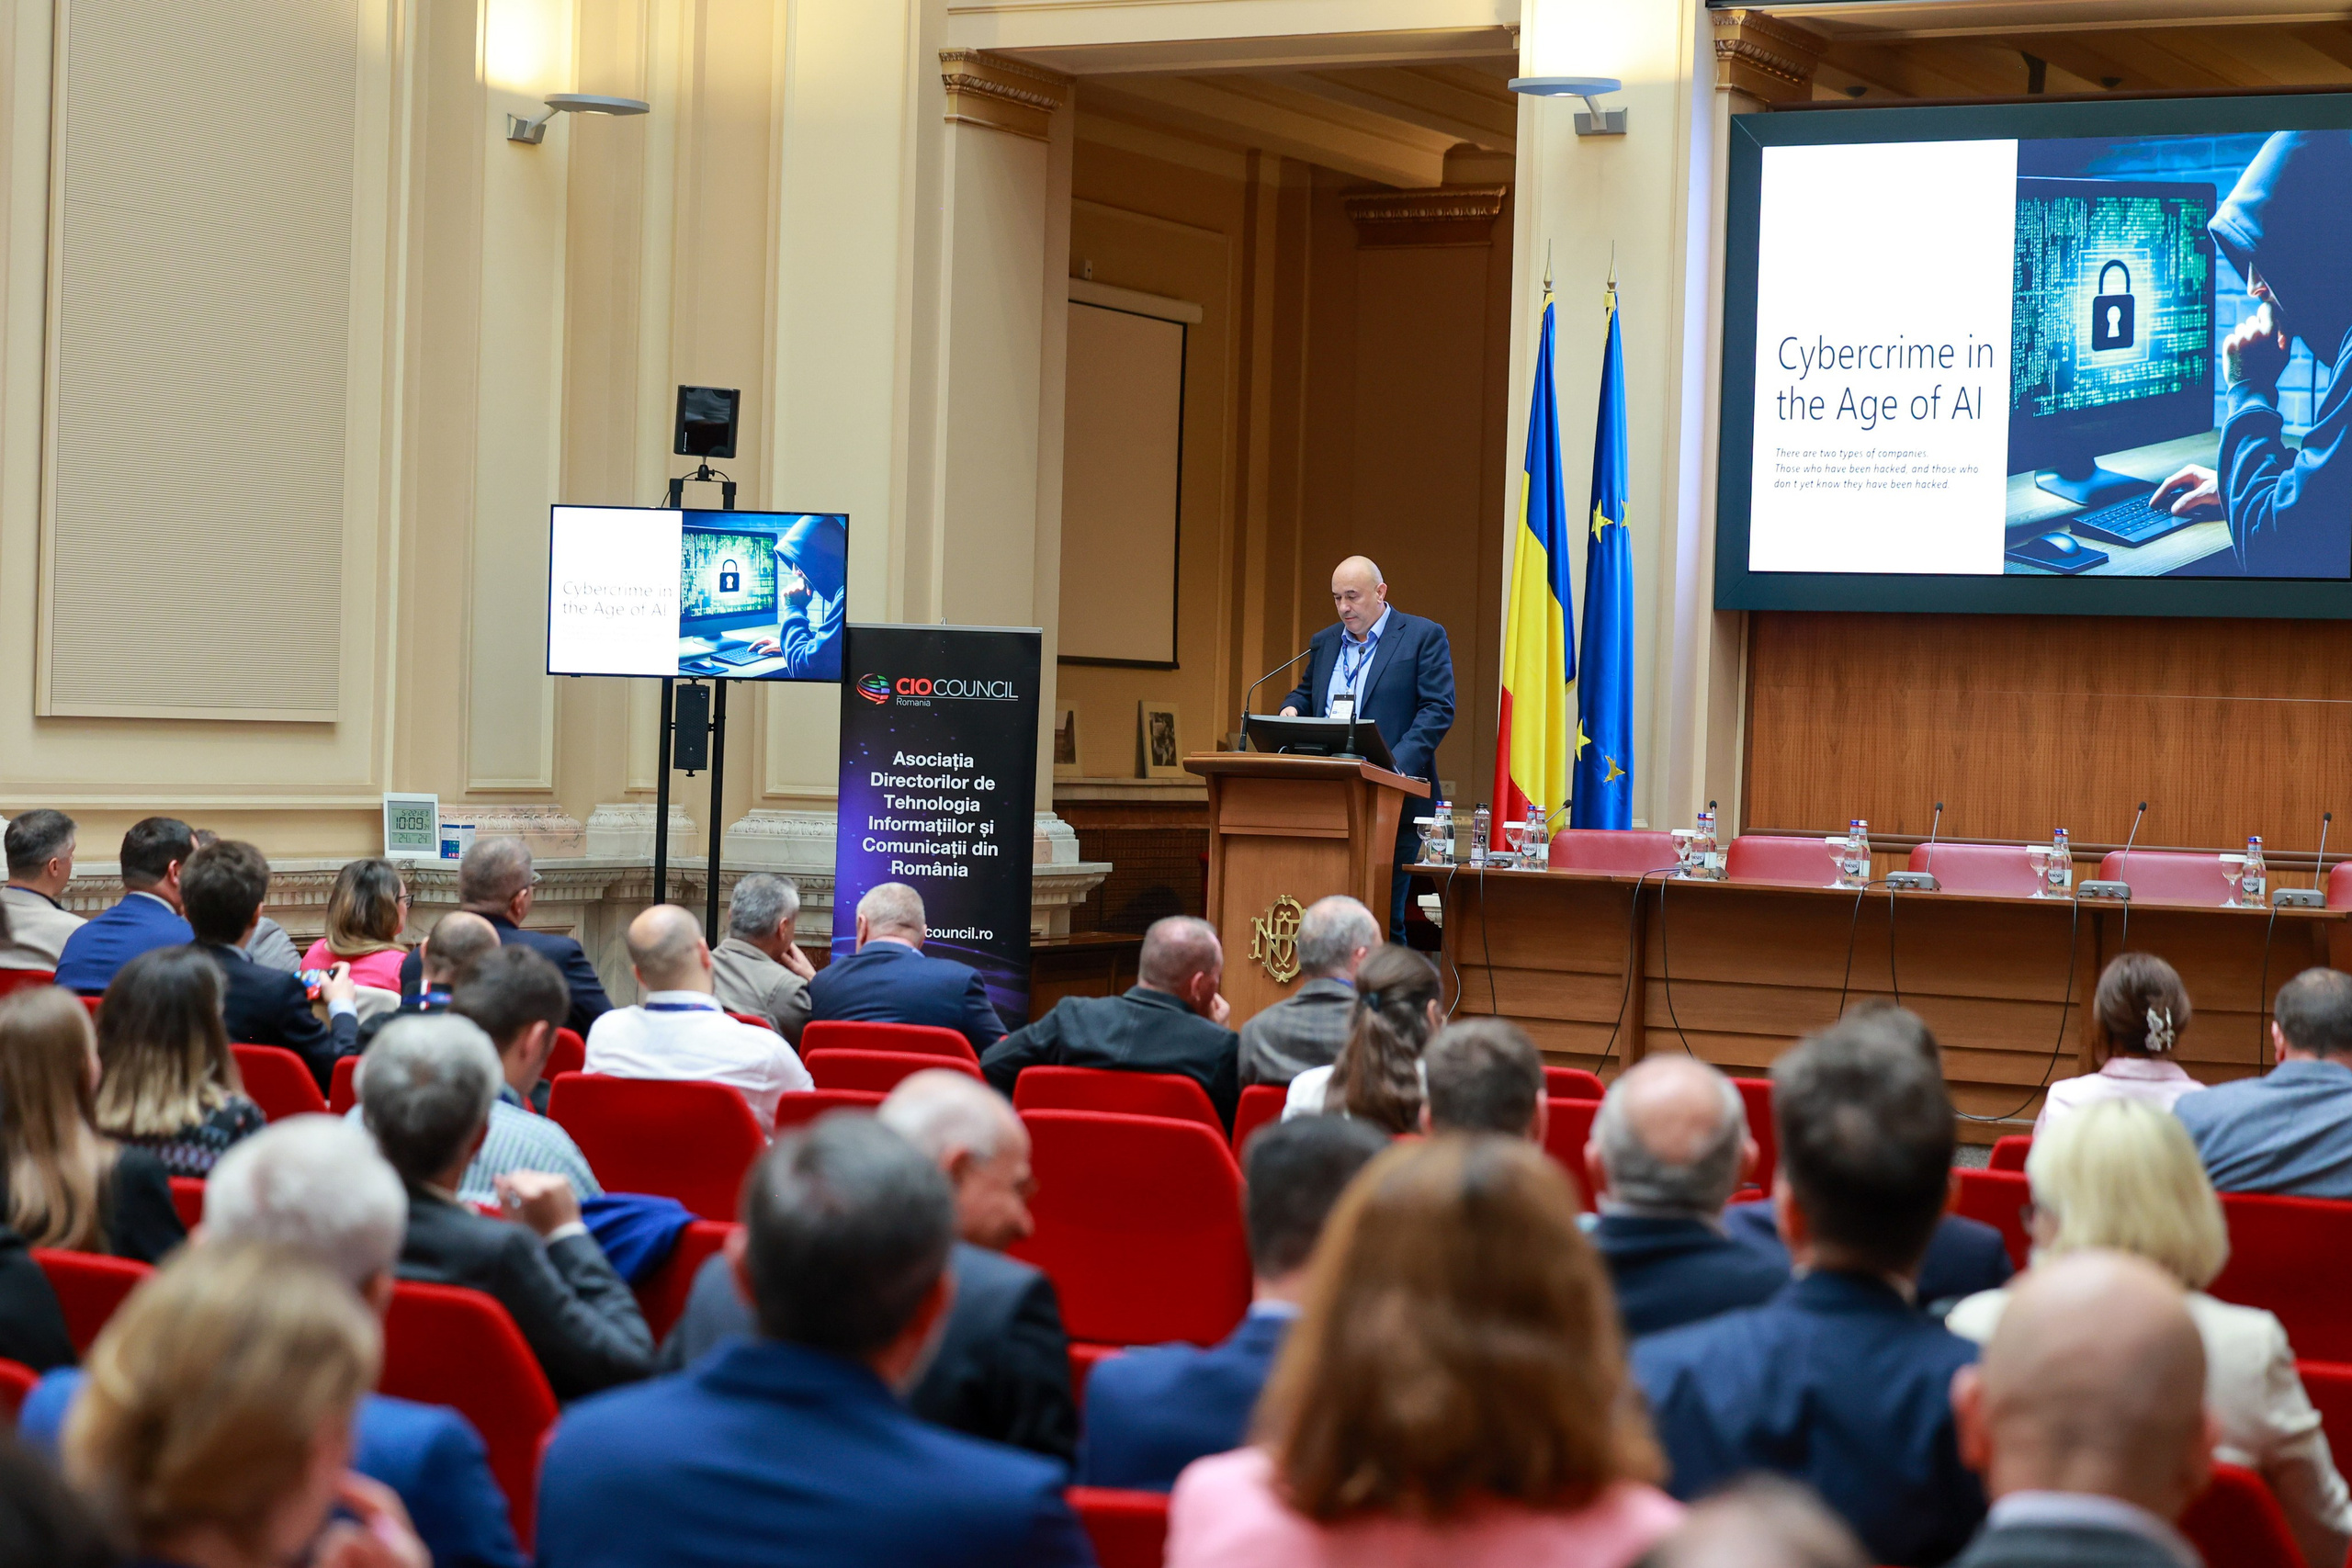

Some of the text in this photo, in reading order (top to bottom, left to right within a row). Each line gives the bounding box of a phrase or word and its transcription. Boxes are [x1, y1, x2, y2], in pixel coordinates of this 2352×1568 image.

[1779, 333, 1993, 380] Cybercrime in
[1777, 384, 1981, 431] the Age of AI
[1776, 447, 1801, 457] There
[1820, 449, 1837, 457] two
[1839, 449, 1863, 460] types
[1865, 447, 1876, 459] of
[1877, 448, 1929, 460] companies.
[1775, 463, 1979, 475] Those who have been hacked, and those who
[1800, 479, 1814, 491] yet
[1816, 479, 1840, 489] know
[1843, 479, 1863, 491] they
[1866, 479, 1887, 489] have
[1891, 479, 1912, 489] been
[1915, 479, 1950, 490] hacked.
[563, 581, 673, 599] Cybercrime in
[563, 600, 587, 615] the
[594, 602, 625, 619] Age
[650, 604, 666, 616] AI
[896, 697, 931, 707] Romania
[892, 750, 974, 772] Asociația
[870, 772, 996, 791] Directorilor de
[884, 794, 980, 815] Tehnologia
[396, 817, 424, 830] 10:09
[868, 815, 994, 838] Informațiilor și
[862, 837, 999, 859] Comunicații din
[891, 860, 968, 877] România
[924, 926, 994, 941] council.ro
